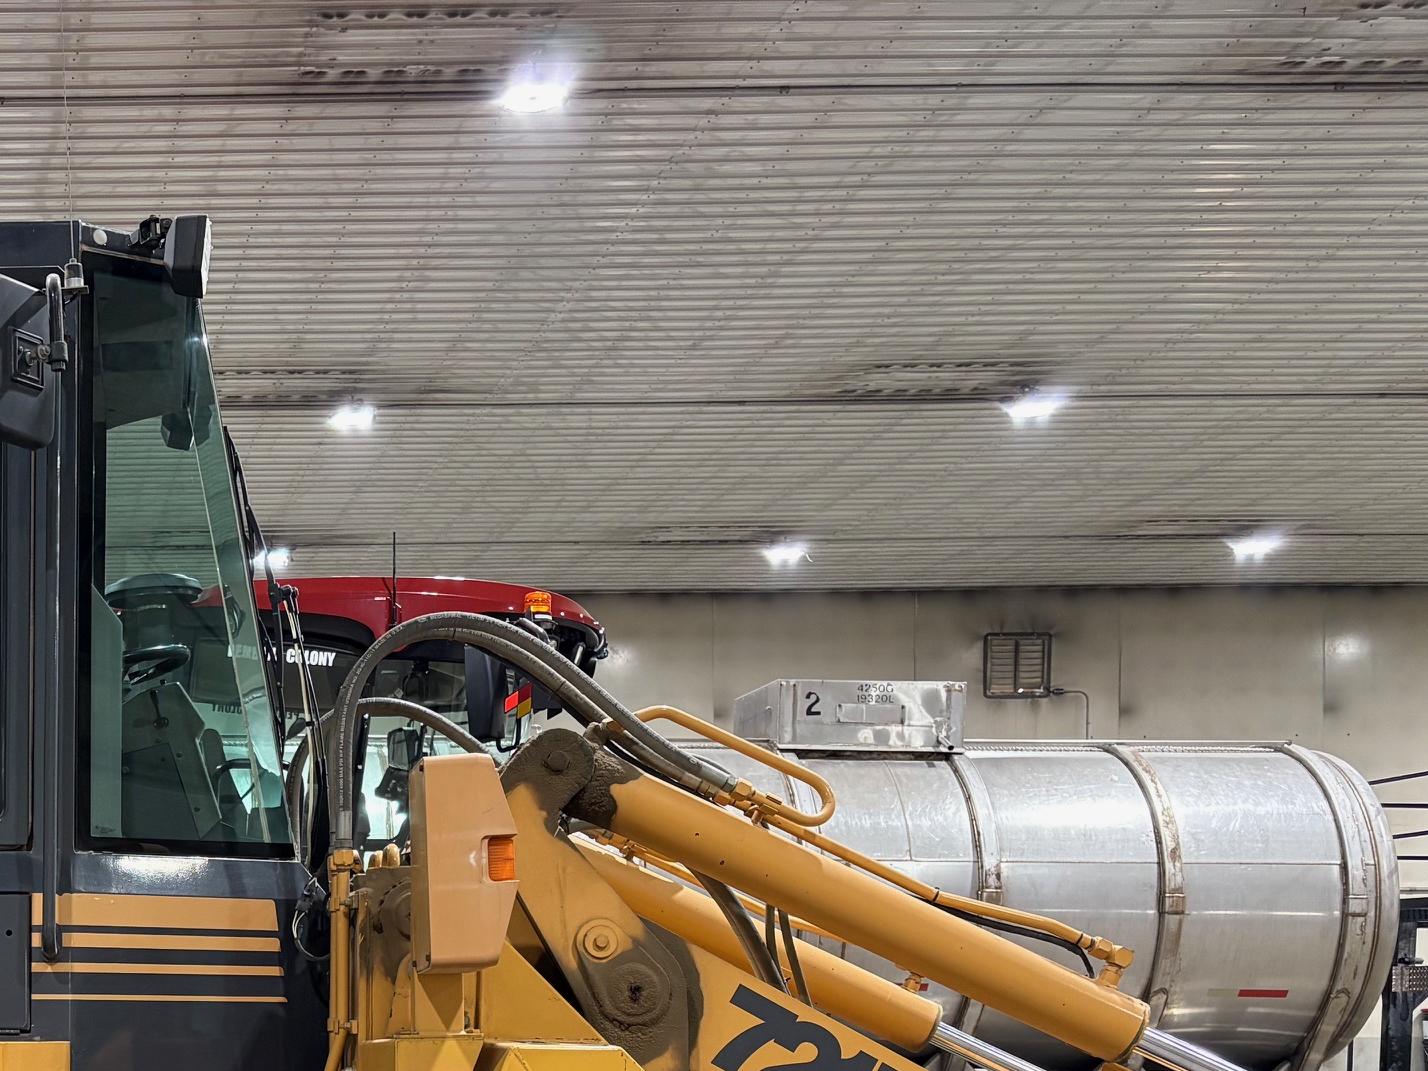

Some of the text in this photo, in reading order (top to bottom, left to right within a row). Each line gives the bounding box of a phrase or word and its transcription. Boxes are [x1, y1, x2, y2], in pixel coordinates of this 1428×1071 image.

[857, 684, 894, 692] 4250G
[857, 694, 894, 703] 19320L
[805, 691, 821, 716] 2
